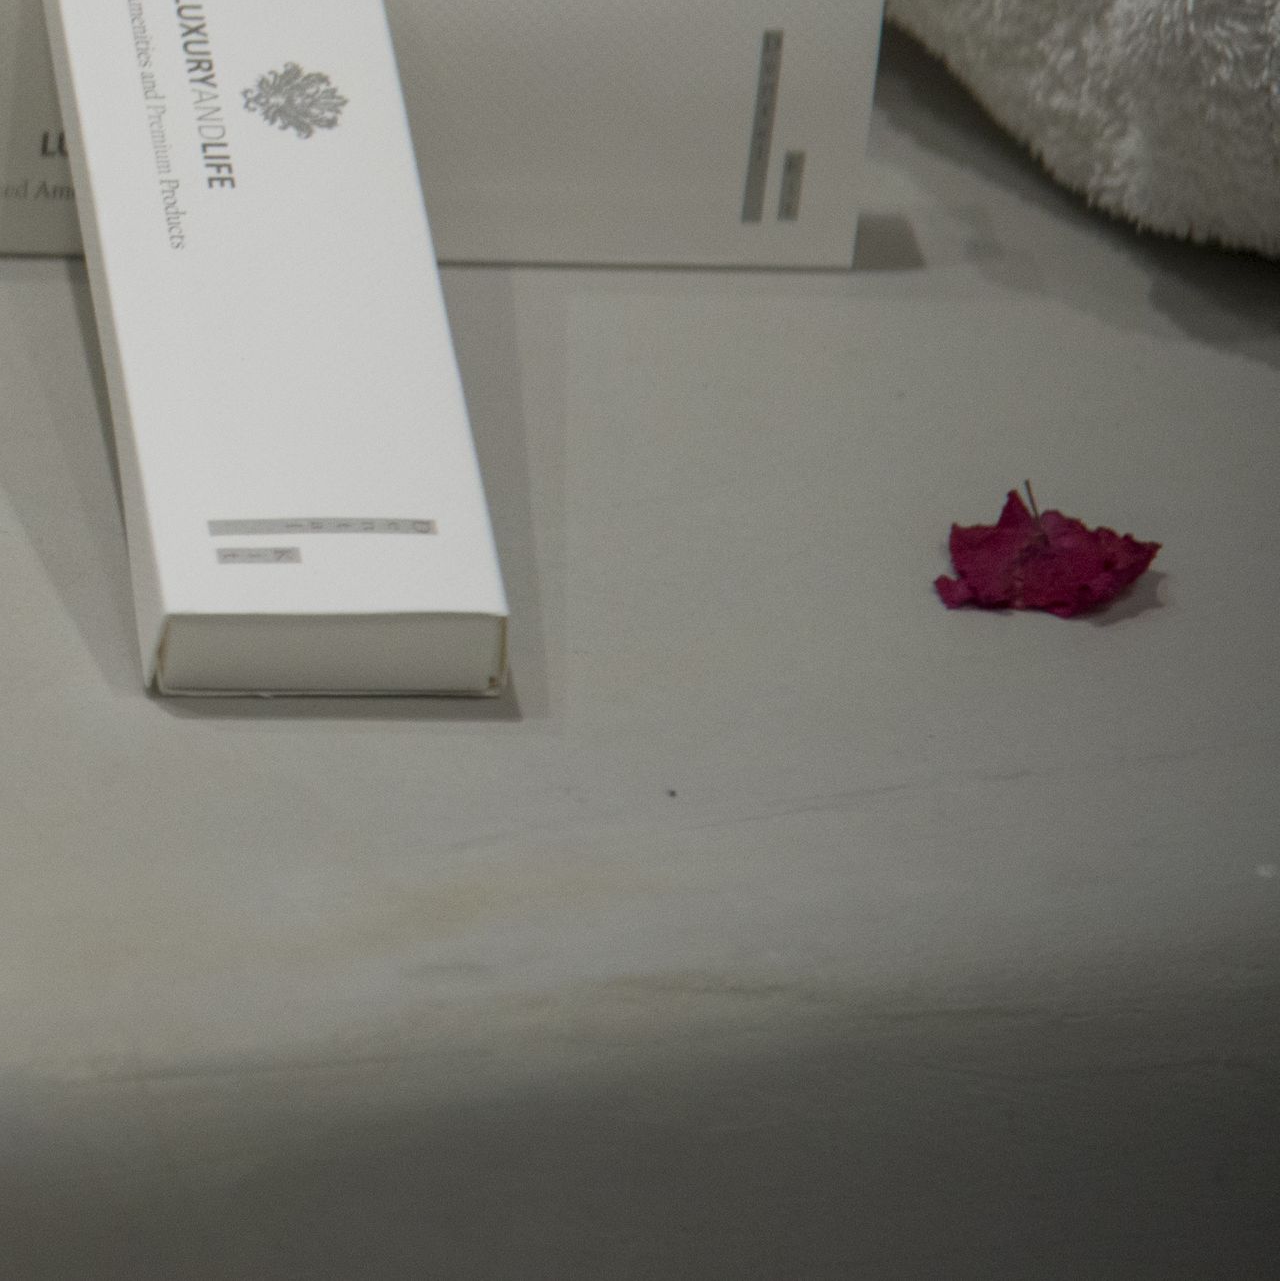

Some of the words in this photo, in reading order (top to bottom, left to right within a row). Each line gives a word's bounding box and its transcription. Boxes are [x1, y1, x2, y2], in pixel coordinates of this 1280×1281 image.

[141, 70, 164, 102] and
[145, 104, 172, 176] Premium
[159, 178, 186, 250] Products
